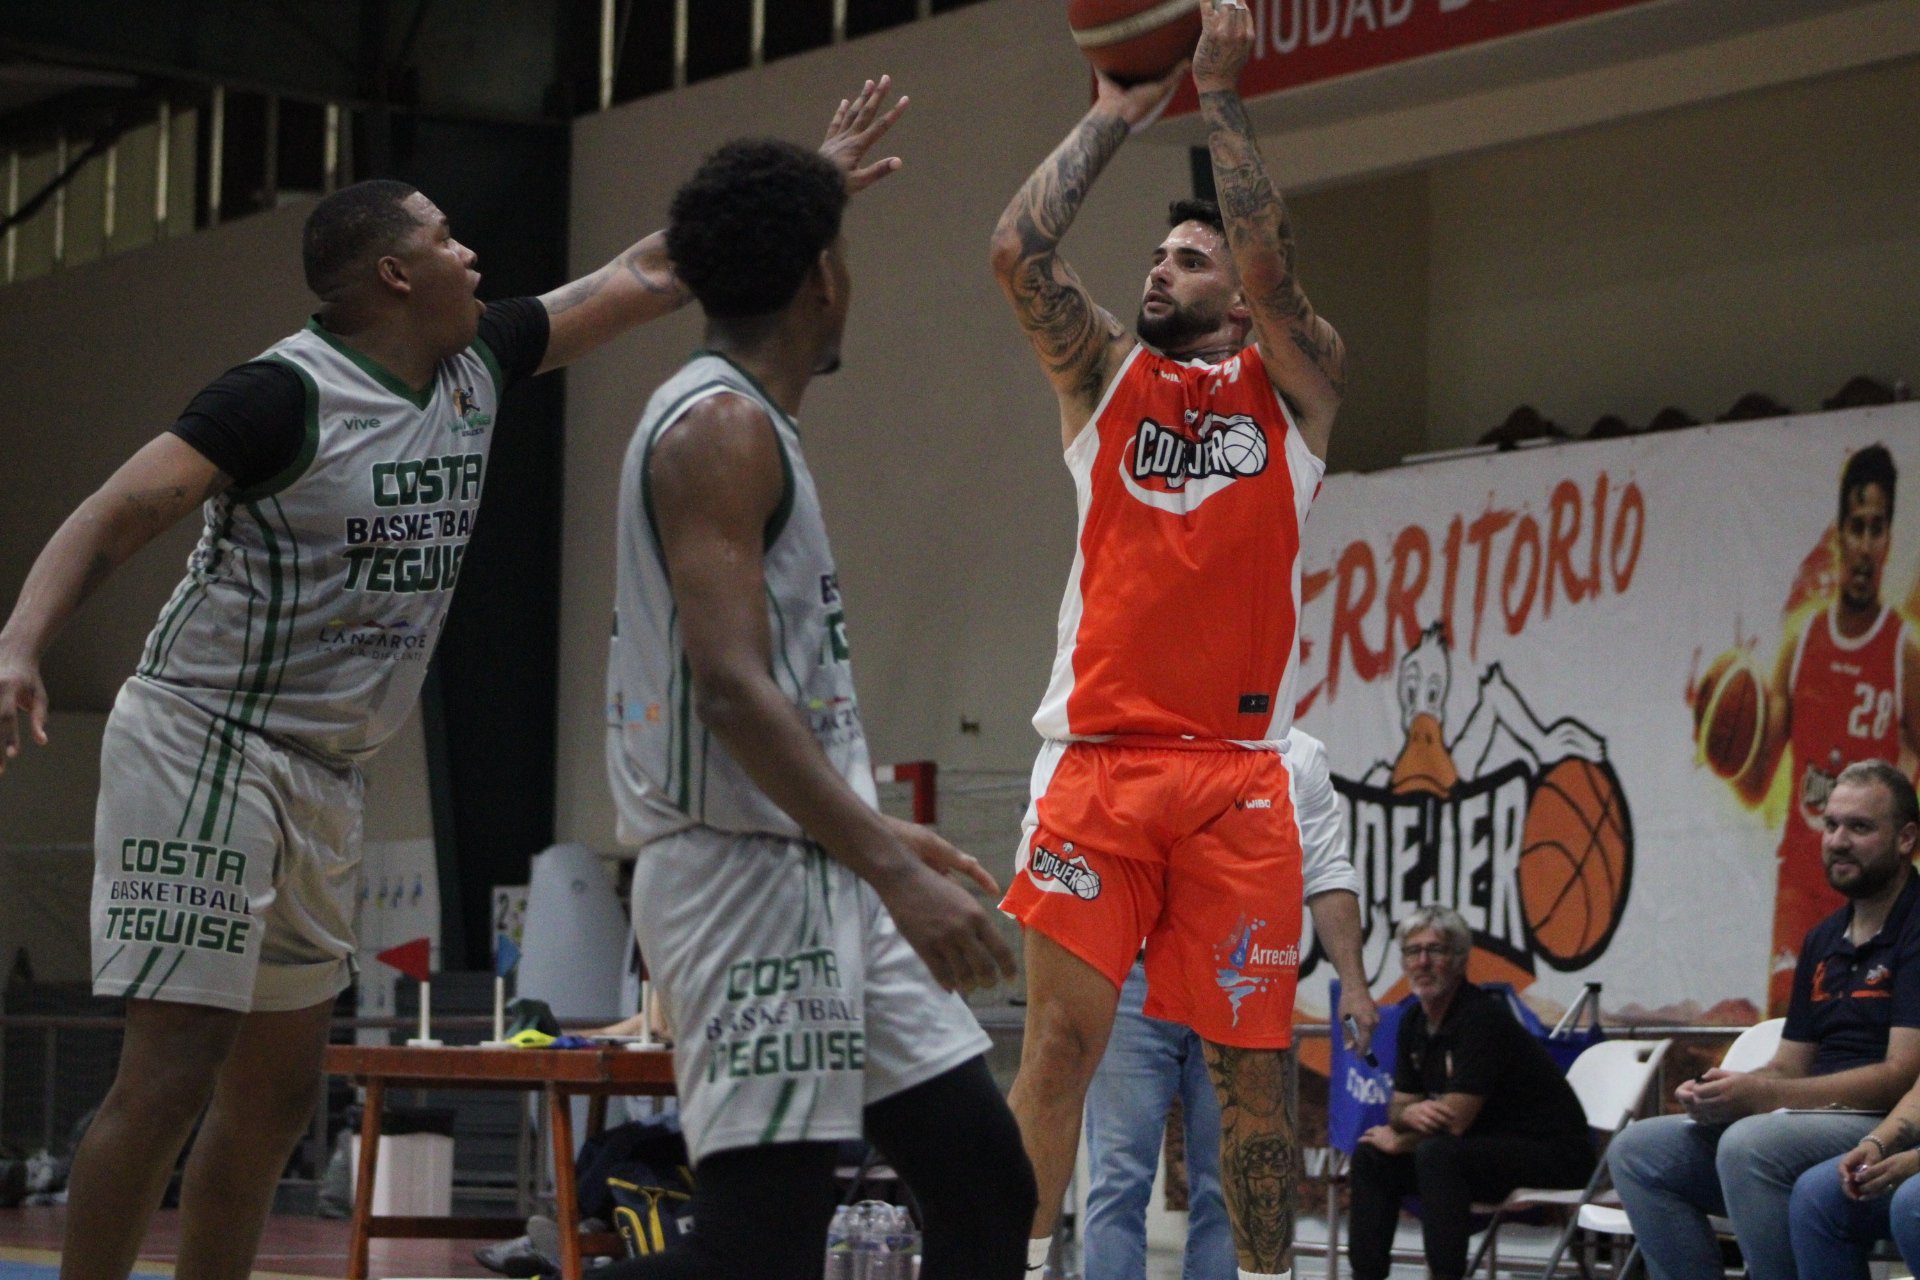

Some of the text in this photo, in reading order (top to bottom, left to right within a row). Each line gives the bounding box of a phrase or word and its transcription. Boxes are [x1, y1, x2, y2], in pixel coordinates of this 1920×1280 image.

[344, 416, 382, 431] vive
[372, 453, 483, 506] COSTA
[1848, 682, 1894, 740] 28
[121, 838, 247, 886] COSTA
[110, 880, 253, 915] BASKETBALL
[106, 907, 250, 954] TEGUISE
[727, 948, 842, 1001] COSTA
[1249, 943, 1298, 966] Arrecife
